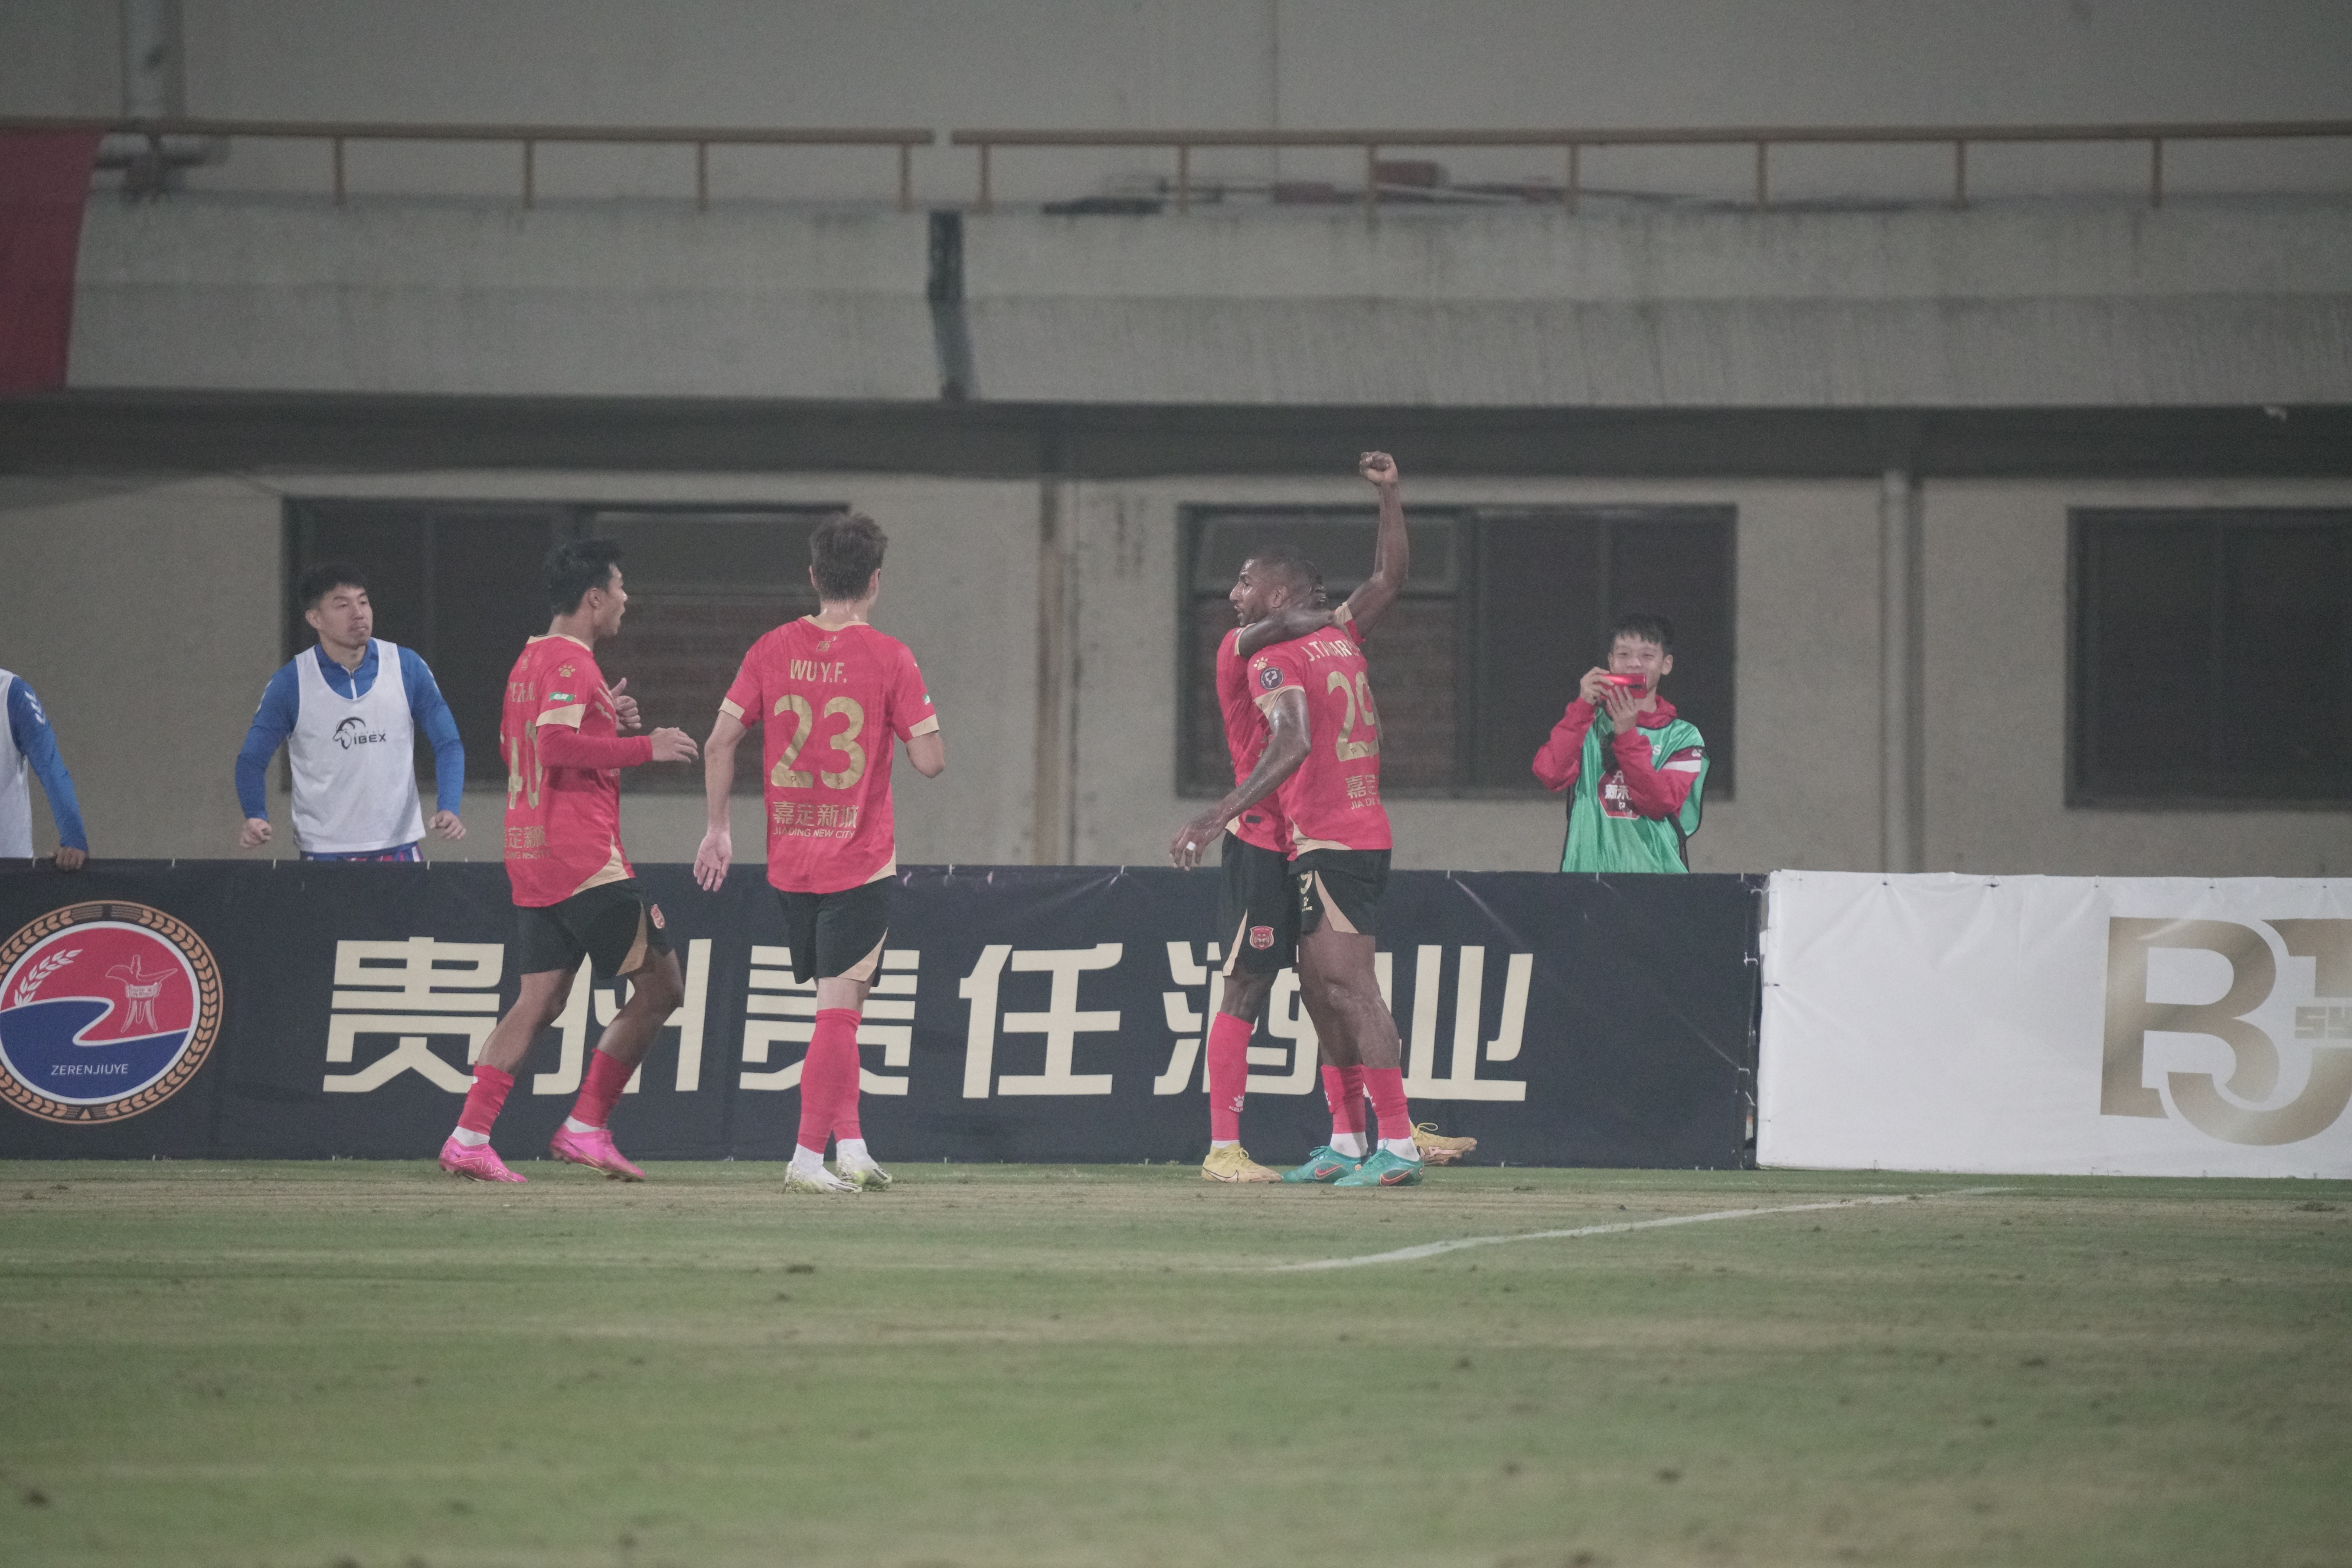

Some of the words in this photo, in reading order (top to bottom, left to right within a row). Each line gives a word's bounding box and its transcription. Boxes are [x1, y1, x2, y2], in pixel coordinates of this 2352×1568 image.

[790, 659, 818, 681] WU
[821, 662, 847, 683] Y.F.
[771, 694, 865, 789] 23
[773, 801, 858, 828] 嘉定新城
[813, 829, 834, 837] NEW
[835, 830, 855, 838] CITY
[51, 1063, 129, 1076] ZERENJIUYE
